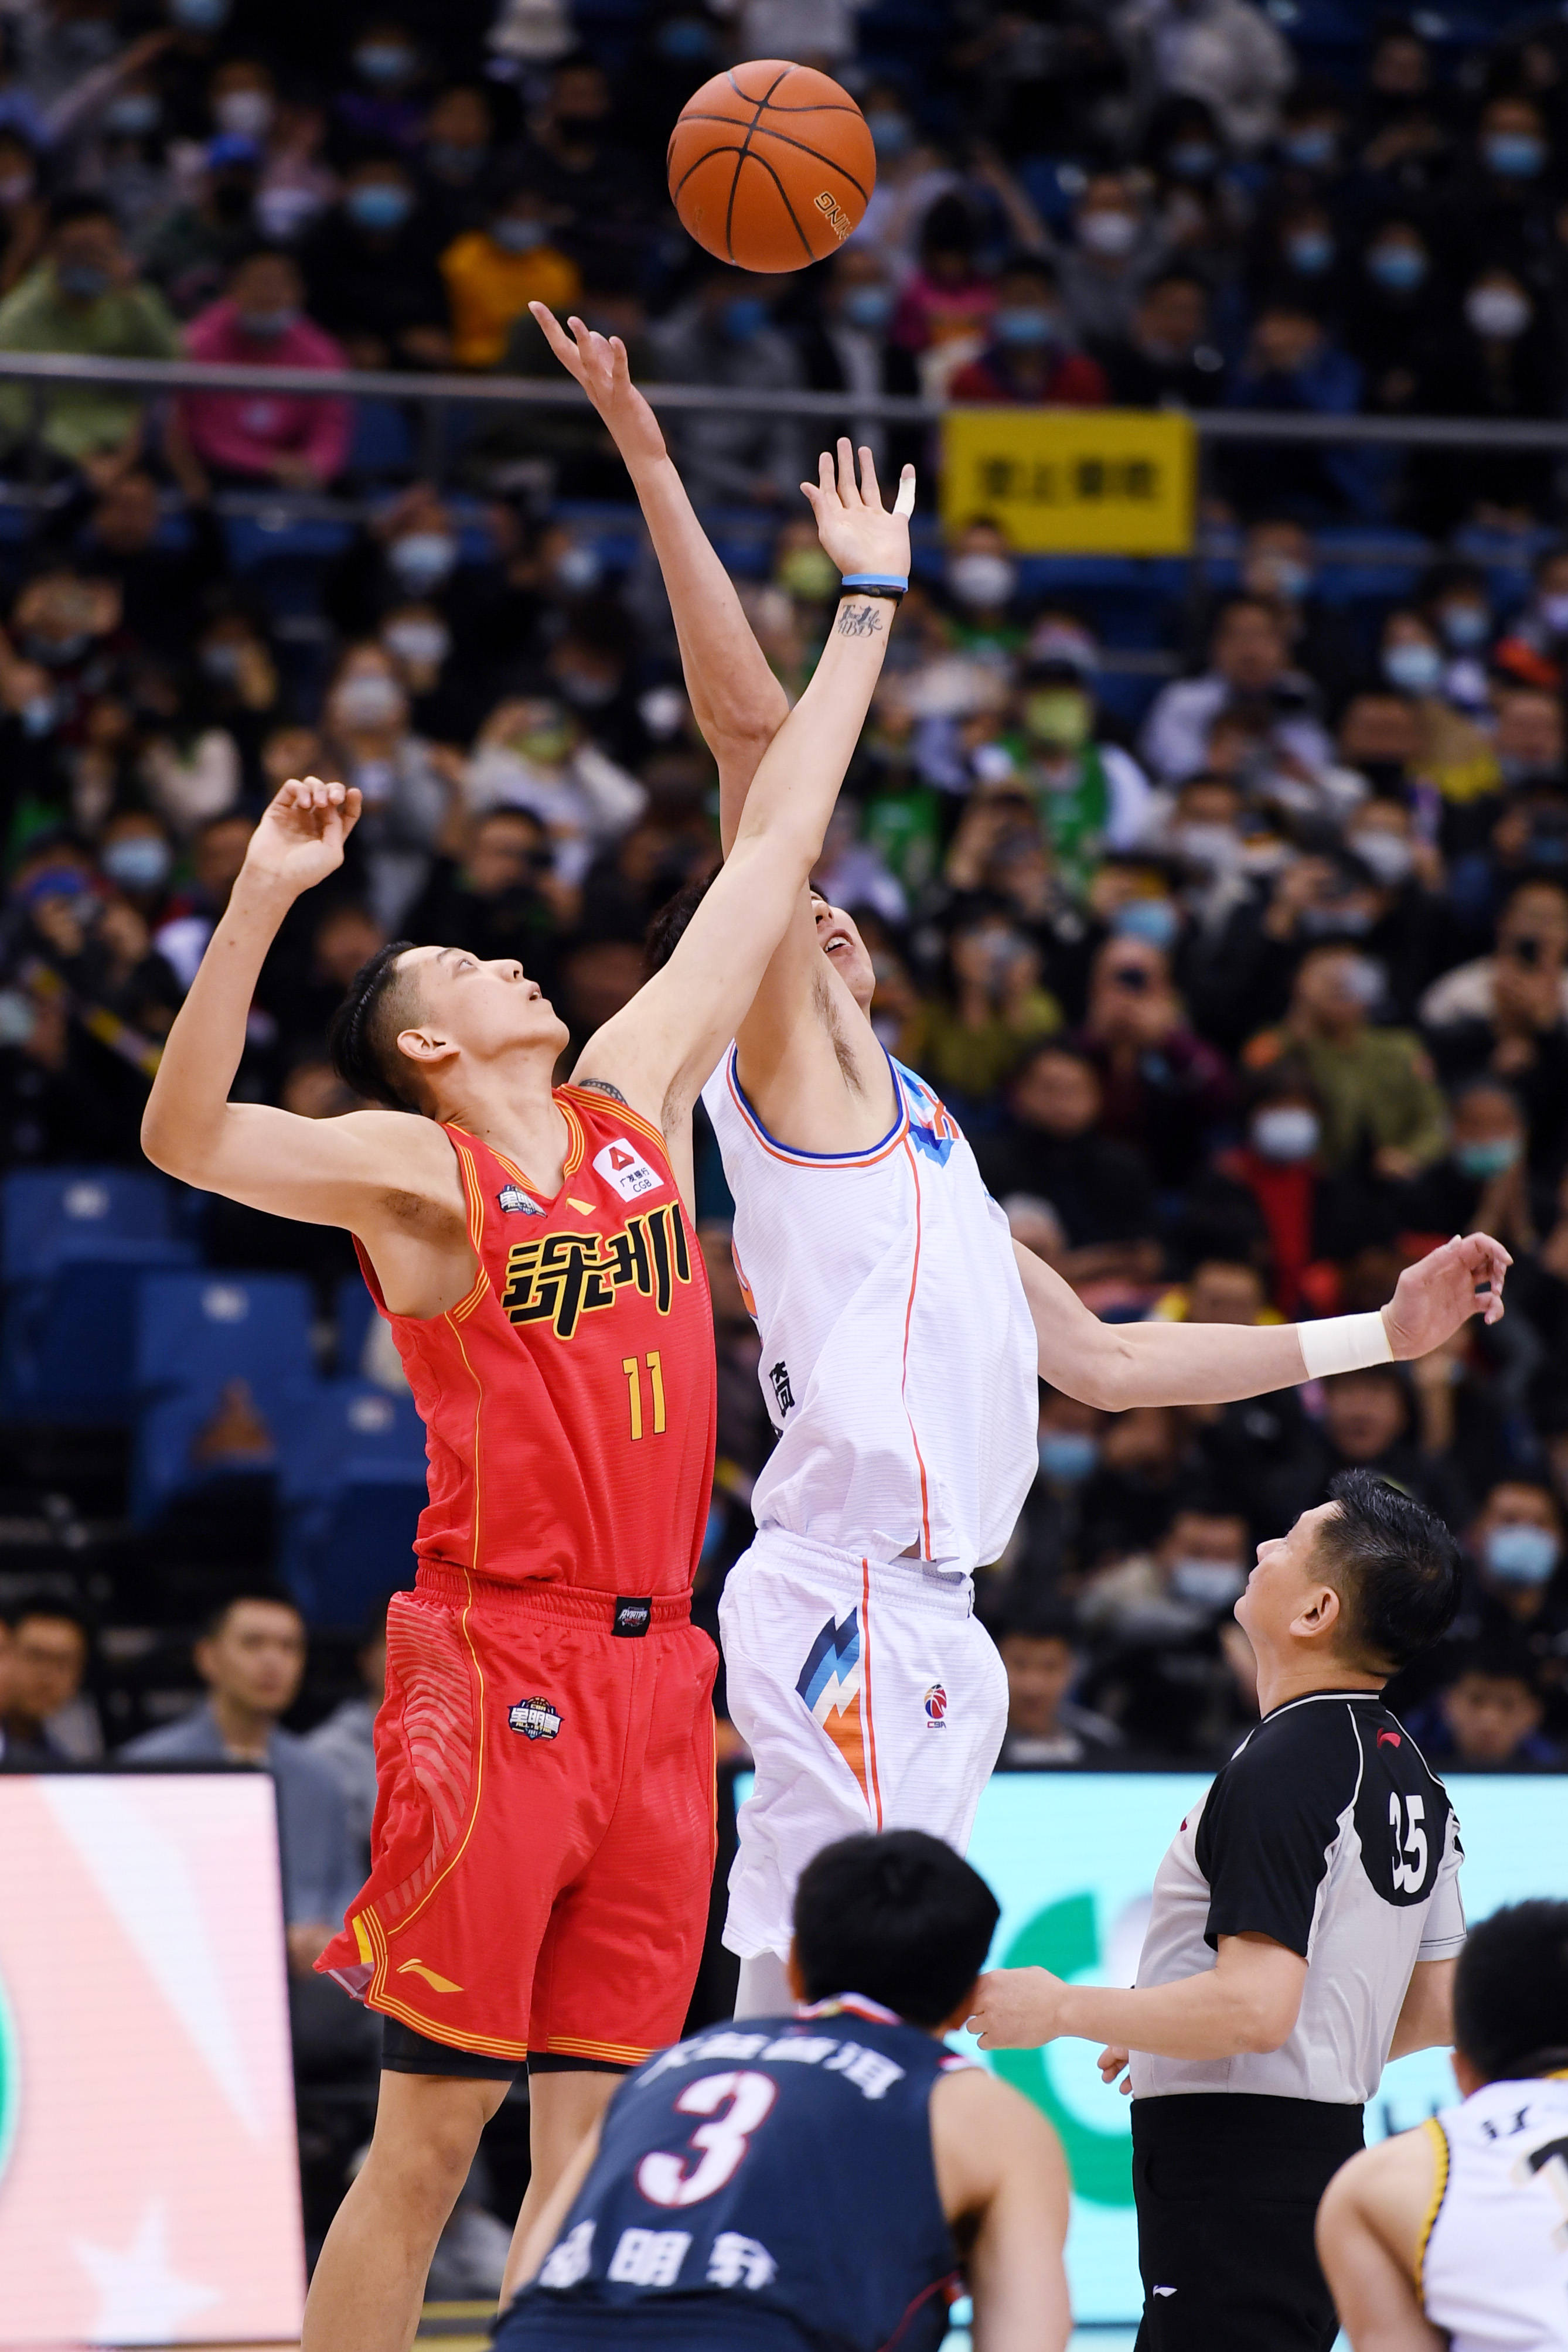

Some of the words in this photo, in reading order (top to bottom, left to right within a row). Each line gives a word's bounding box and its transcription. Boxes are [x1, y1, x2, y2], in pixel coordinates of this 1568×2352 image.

[633, 1178, 652, 1192] CGB
[622, 1349, 667, 1441] 11
[1389, 1791, 1429, 1894] 35
[636, 2070, 779, 2210] 3
